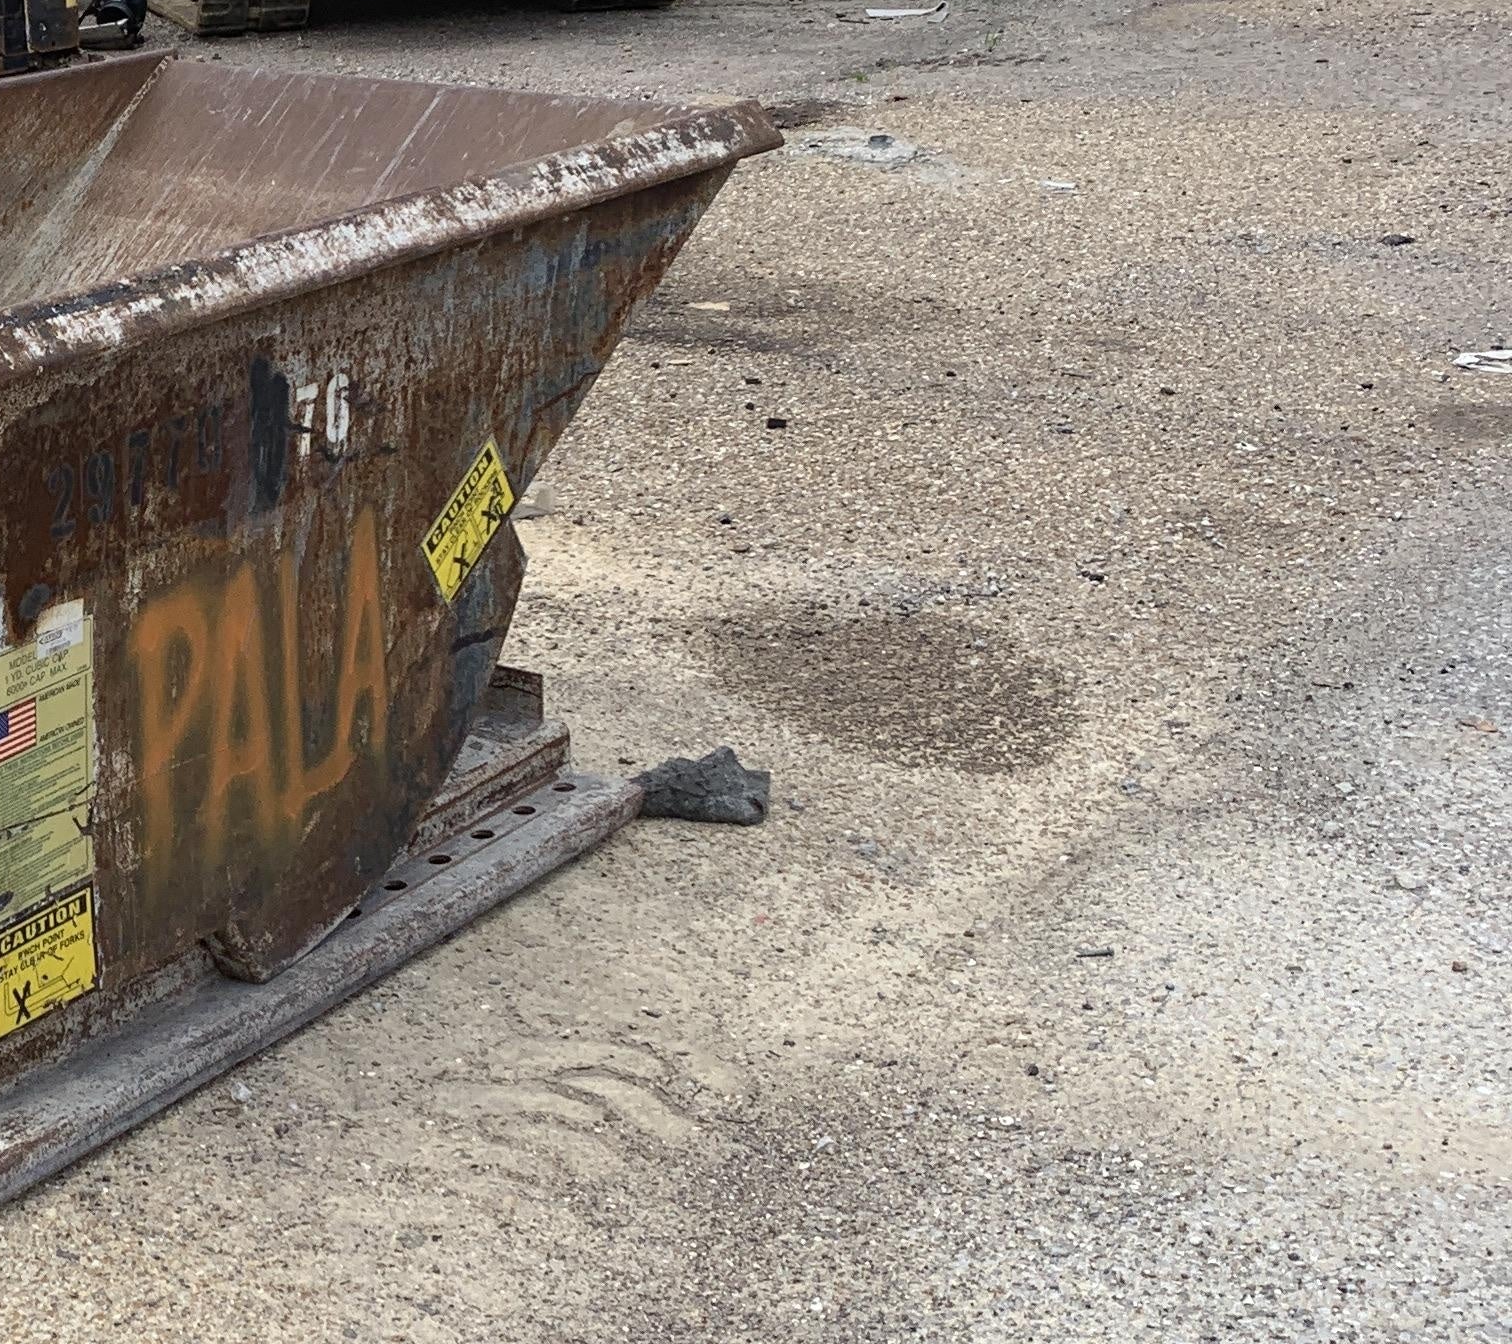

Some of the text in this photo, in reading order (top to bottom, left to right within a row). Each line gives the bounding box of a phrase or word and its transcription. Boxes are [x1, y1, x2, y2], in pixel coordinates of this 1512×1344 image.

[431, 456, 489, 546] CAUTION
[128, 506, 389, 856] PALA
[0, 897, 82, 955] CAUTION
[42, 929, 66, 948] POINT
[0, 965, 18, 984] STAY
[59, 929, 86, 950] FORKS
